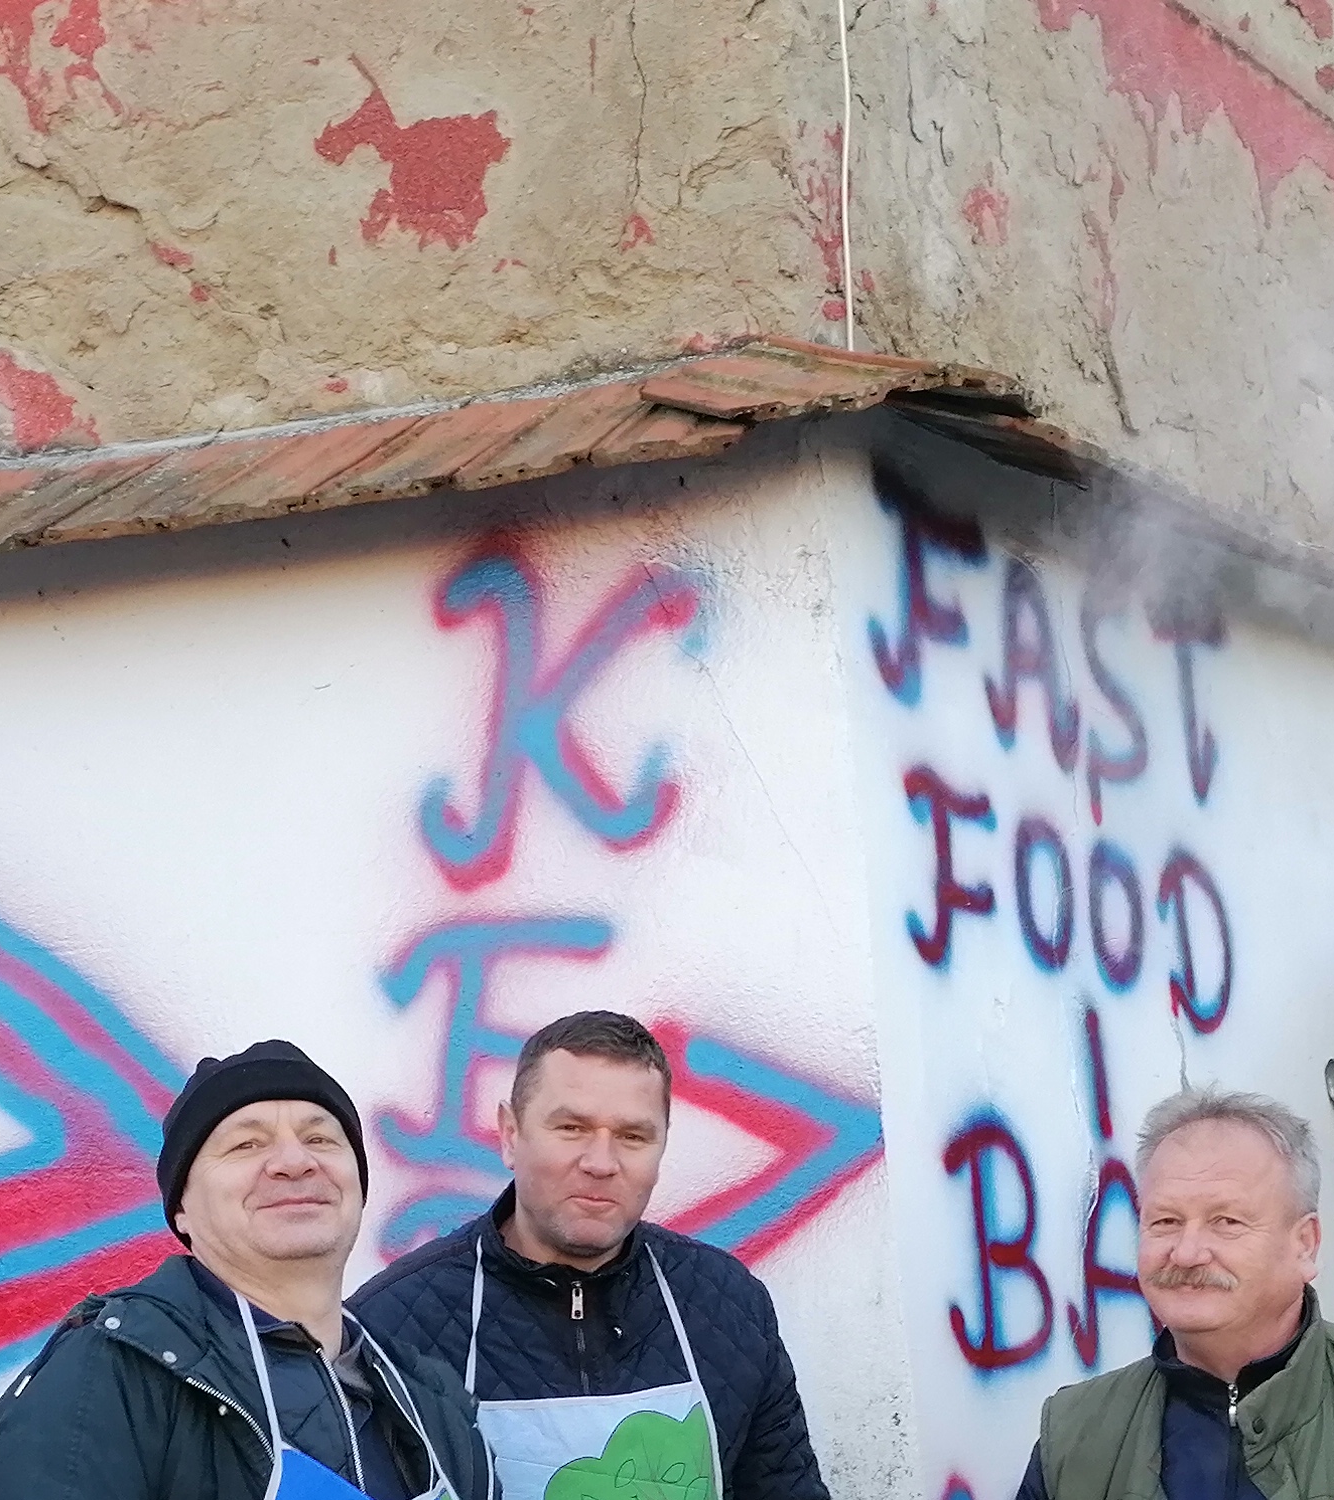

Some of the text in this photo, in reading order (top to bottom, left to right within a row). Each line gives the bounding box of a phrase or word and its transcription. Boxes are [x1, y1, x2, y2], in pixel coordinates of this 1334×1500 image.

[867, 493, 1230, 822] FAST
[902, 765, 1233, 1034] FOOD
[941, 1122, 1167, 1370] BA
